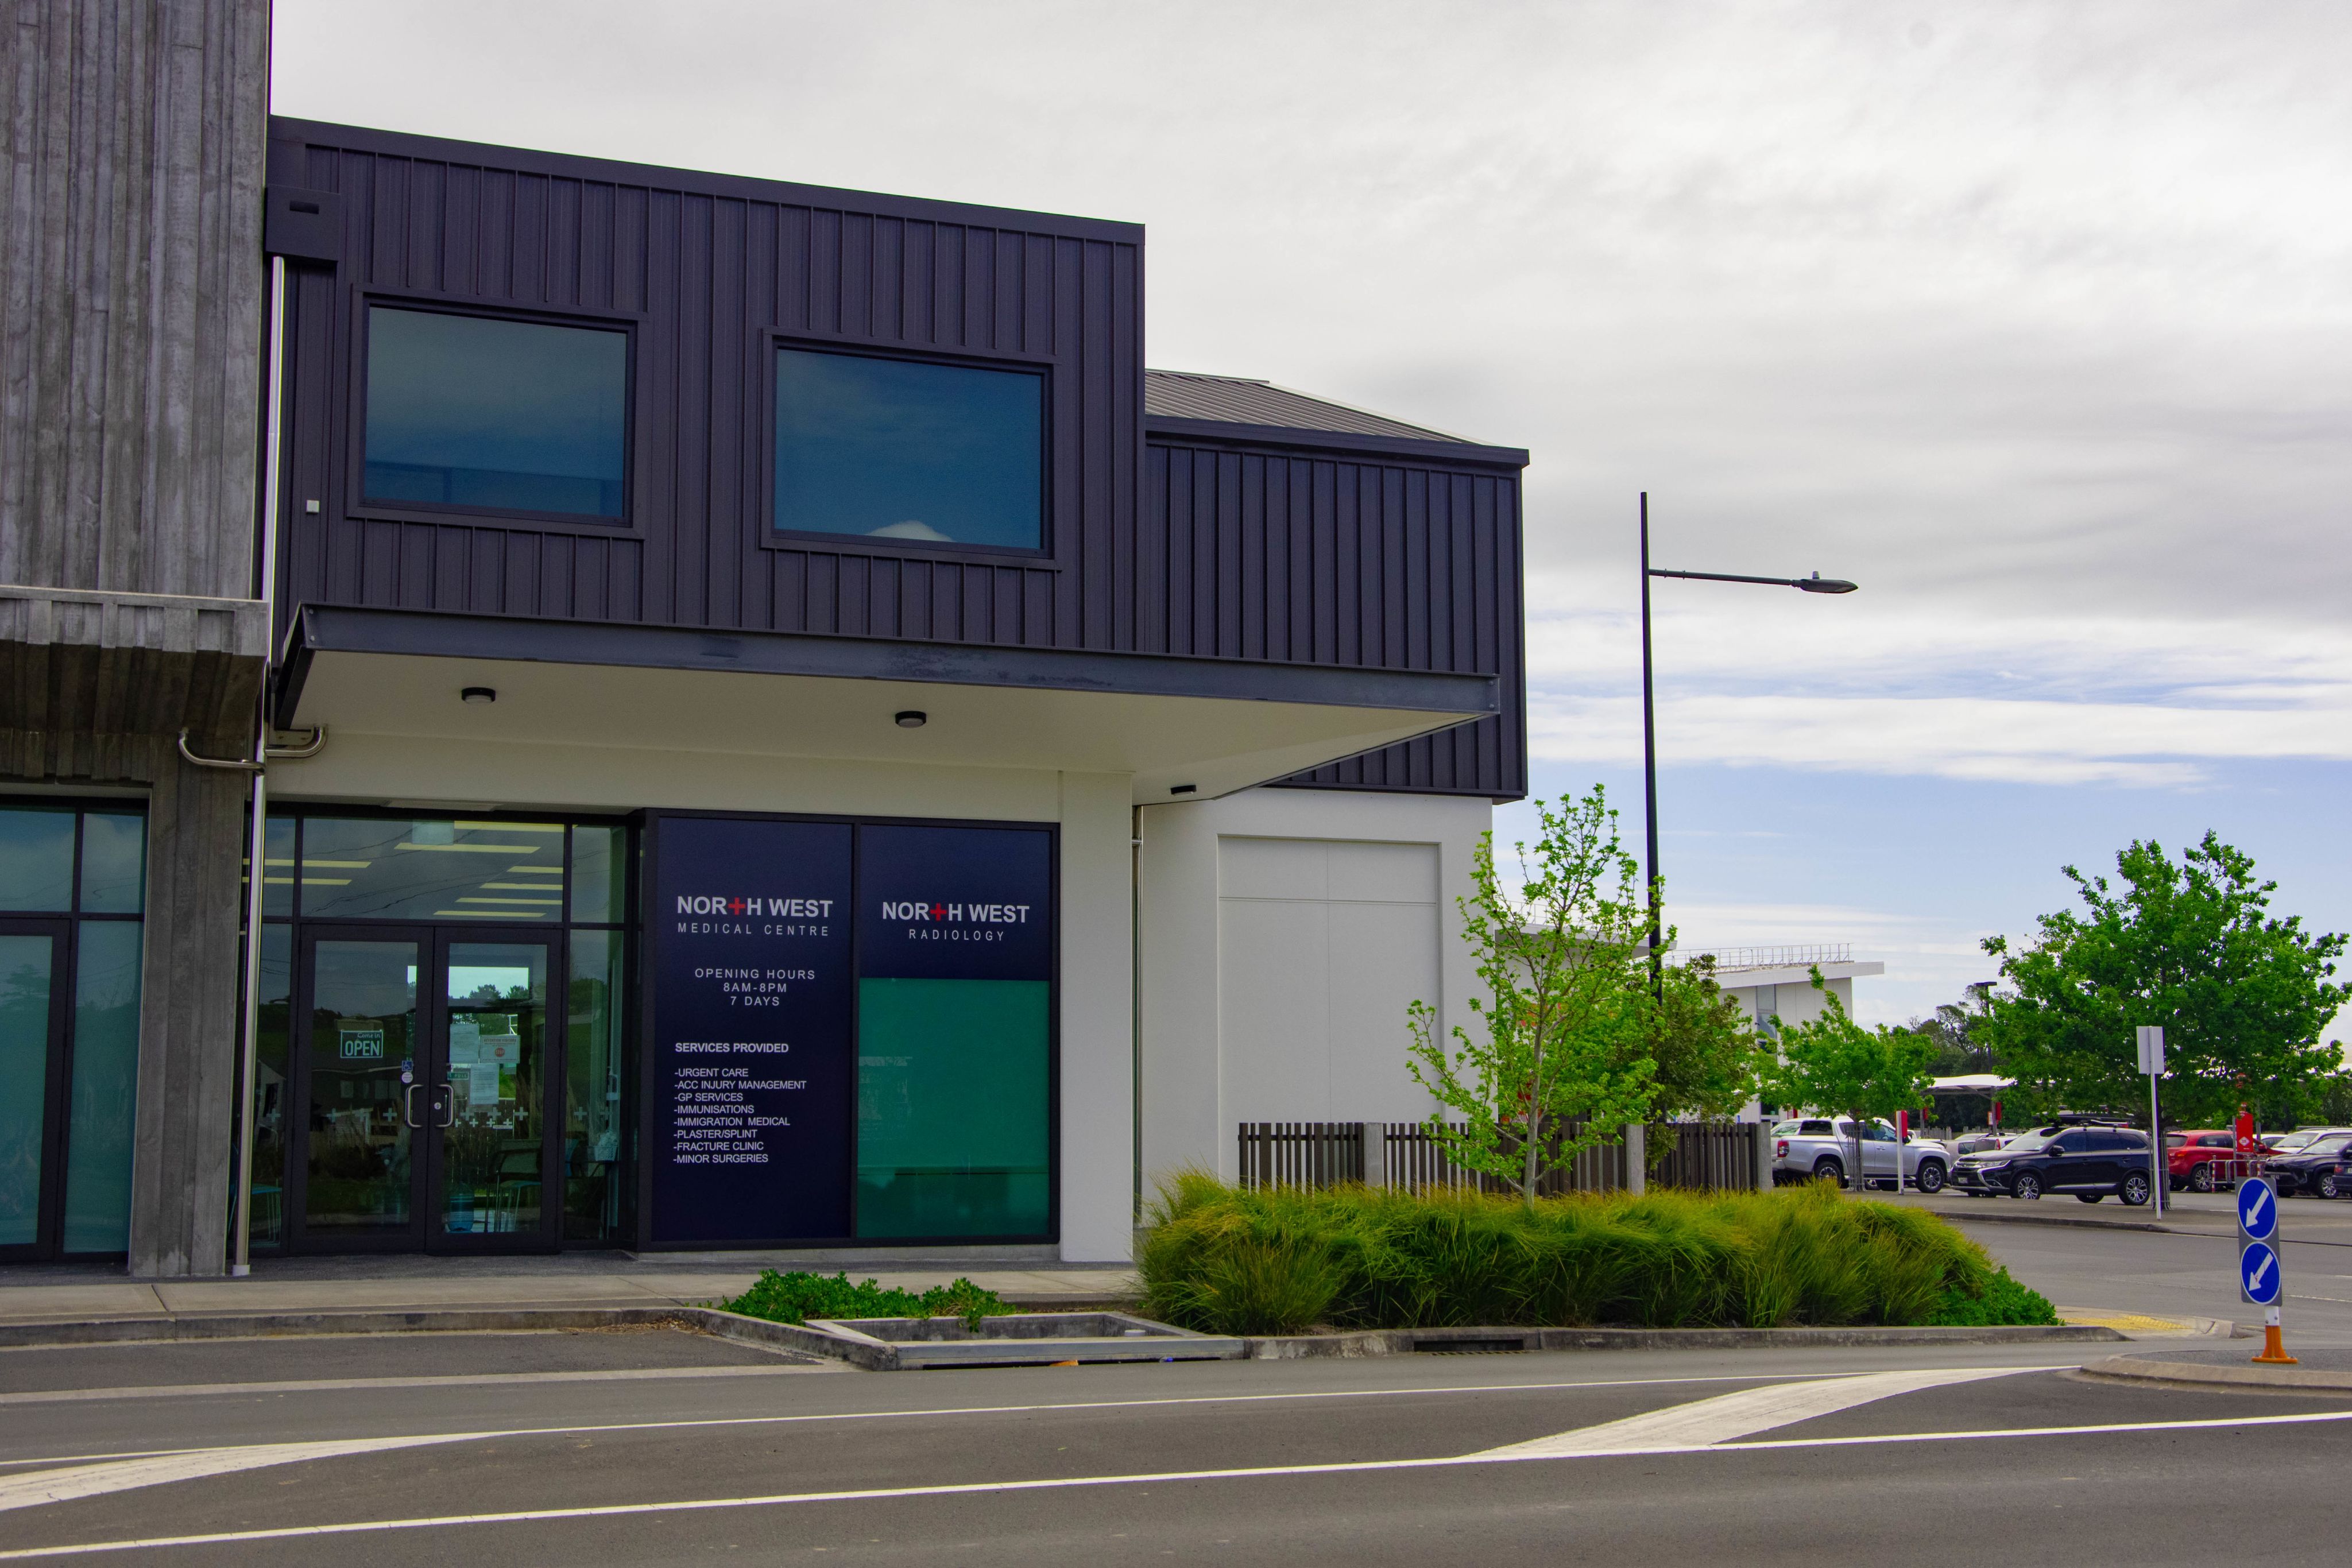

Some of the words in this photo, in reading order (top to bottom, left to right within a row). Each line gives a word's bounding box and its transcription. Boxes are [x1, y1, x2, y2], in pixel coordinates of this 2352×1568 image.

[768, 899, 834, 918] WEST
[968, 904, 1030, 924] WEST
[678, 922, 752, 935] MEDICAL
[764, 924, 829, 936] CENTRE
[908, 928, 1004, 942] RADIOLOGY
[694, 968, 760, 979] OPENING
[767, 969, 815, 980] HOURS
[723, 982, 787, 993] 8AM-8PM
[730, 996, 737, 1006] 7
[744, 996, 780, 1006] DAYS
[345, 1040, 380, 1056] OPEN
[675, 1042, 730, 1053] SERVICES
[733, 1042, 790, 1053] PROVIDED
[674, 1068, 720, 1077] -URGENT
[721, 1068, 749, 1077] CARE
[674, 1080, 699, 1090] -ACC
[701, 1080, 736, 1090] INJURY
[738, 1080, 807, 1090] MANAGEMENT
[674, 1093, 693, 1102] -GP
[695, 1093, 744, 1102] SERVICES
[674, 1105, 755, 1114] -IMMUNISATIONS
[674, 1117, 742, 1126] -IMMIGRATION
[748, 1117, 791, 1126] MEDICAL
[674, 1129, 758, 1139] -PLASTER/SPLINT
[673, 1141, 730, 1151] -FRACTURE
[732, 1141, 764, 1151] CLINIC
[673, 1154, 710, 1164] -MINOR
[711, 1153, 769, 1164] SURGERIES
